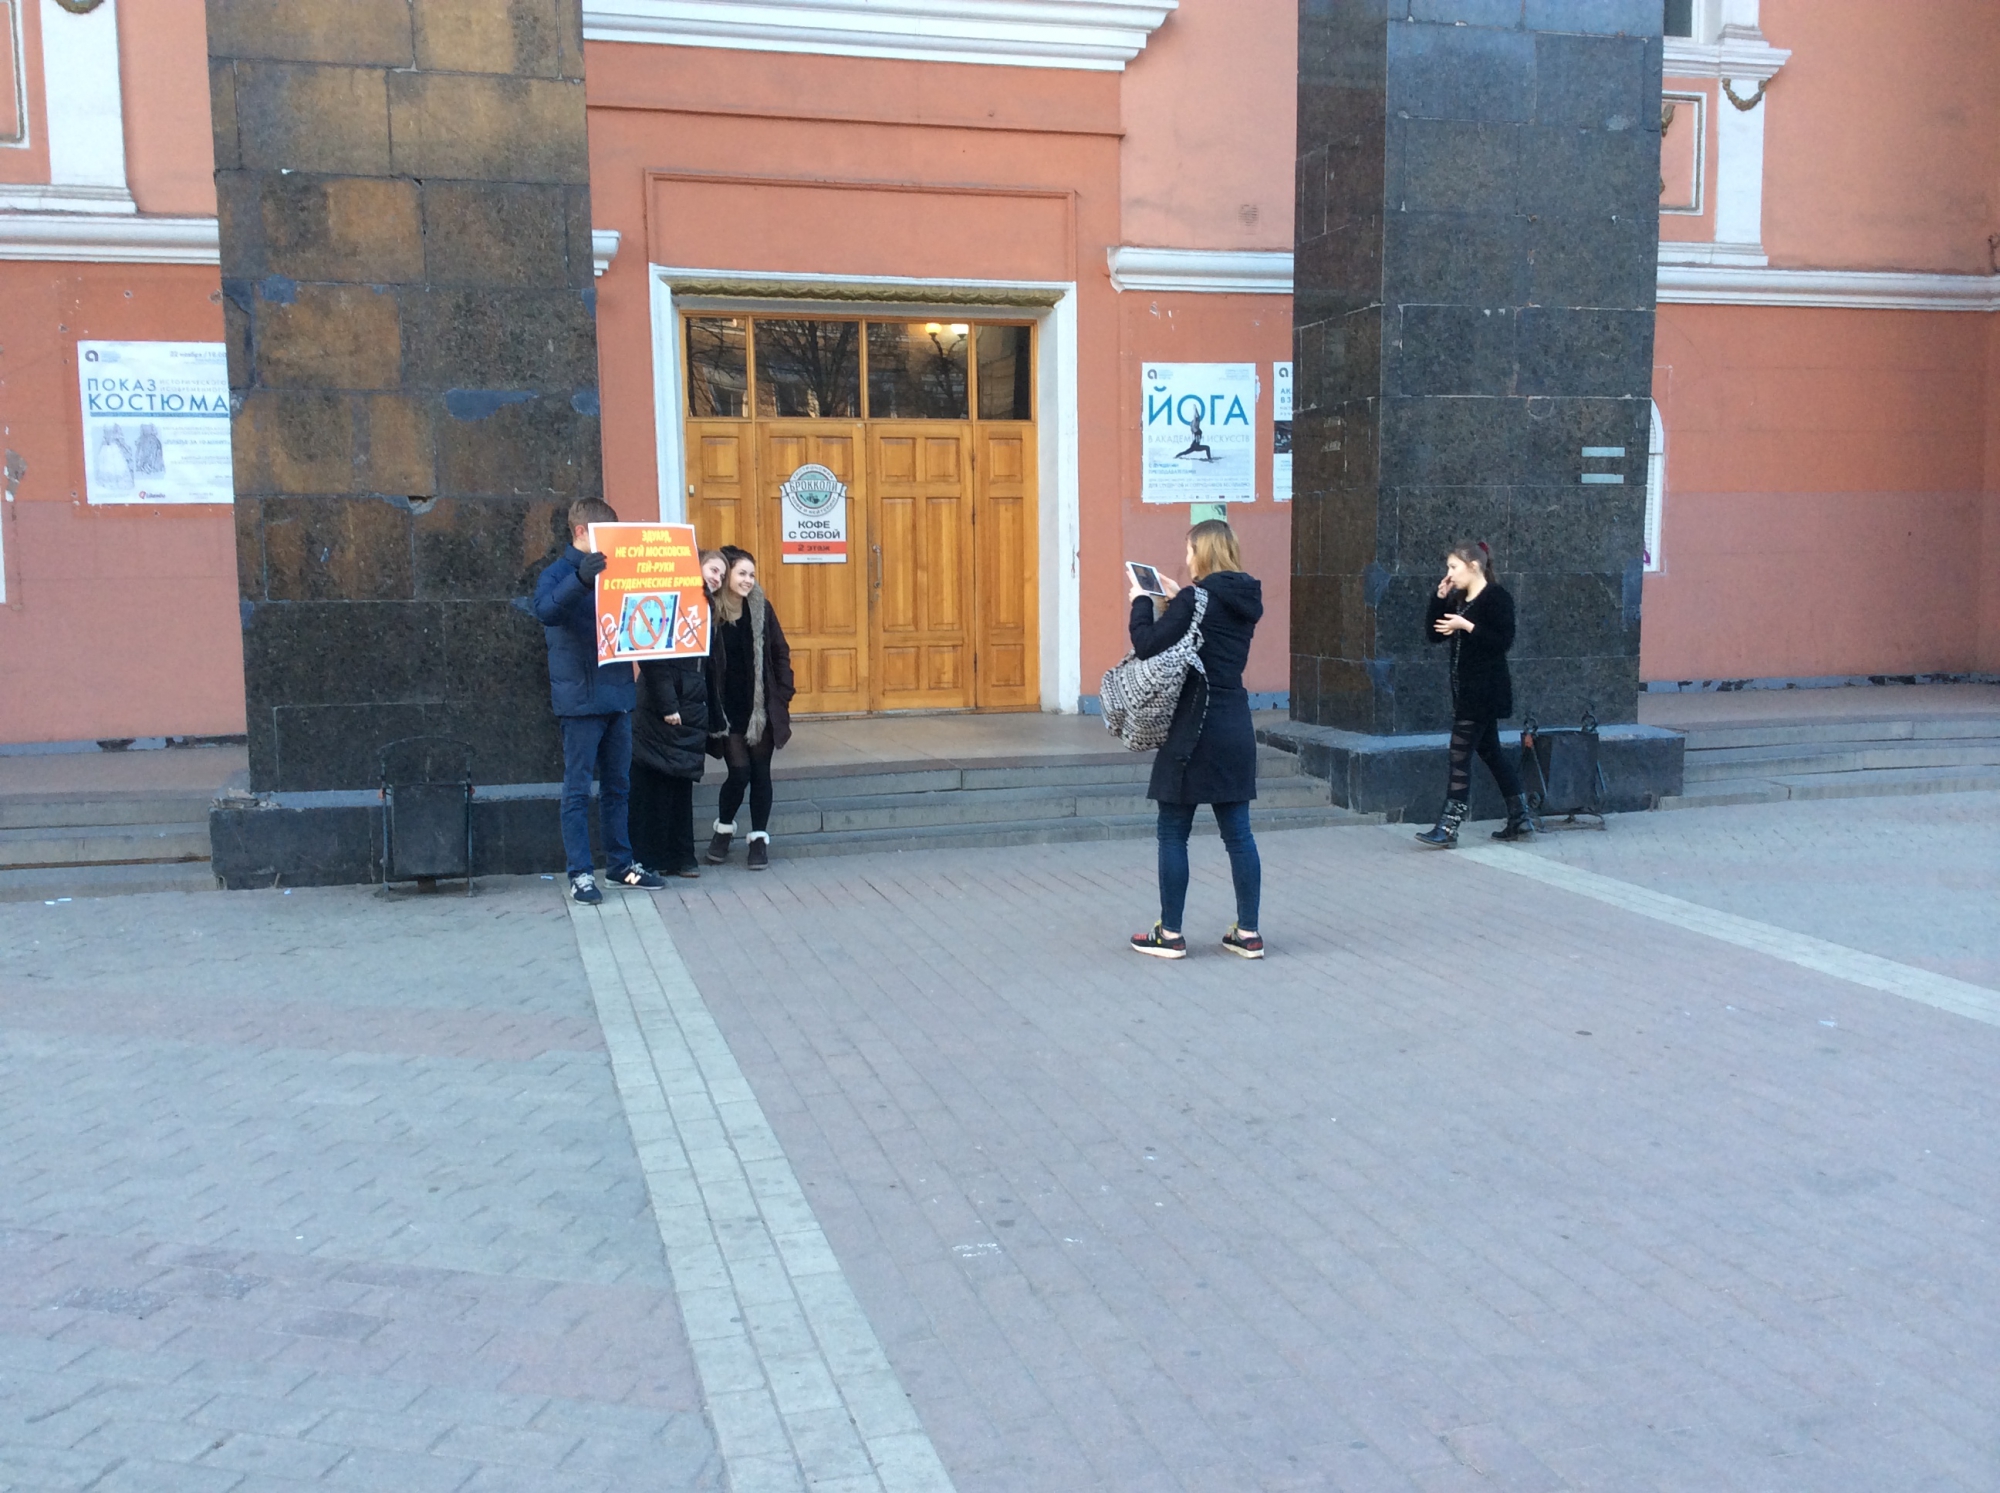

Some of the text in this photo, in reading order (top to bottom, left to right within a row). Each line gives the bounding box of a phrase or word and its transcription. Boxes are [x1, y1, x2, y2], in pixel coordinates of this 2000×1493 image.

[87, 378, 157, 391] ПОКАЗ
[89, 393, 229, 411] КОСТЮМА
[1148, 385, 1249, 426] ЙОГА
[1154, 435, 1204, 444] АКАДЕМИ
[1208, 434, 1250, 443] ИСКУССТВ
[790, 480, 838, 492] БРОККОЛИ
[798, 520, 830, 528] КОФЕ
[788, 528, 840, 539] С СОБОЙ
[614, 546, 626, 558] НЕ
[628, 544, 644, 558] СУЙ
[636, 560, 675, 573] ГЕЙ-РУКИ
[604, 579, 610, 590] В
[610, 577, 672, 591] СТУДЕНЧЕСКИЕ
